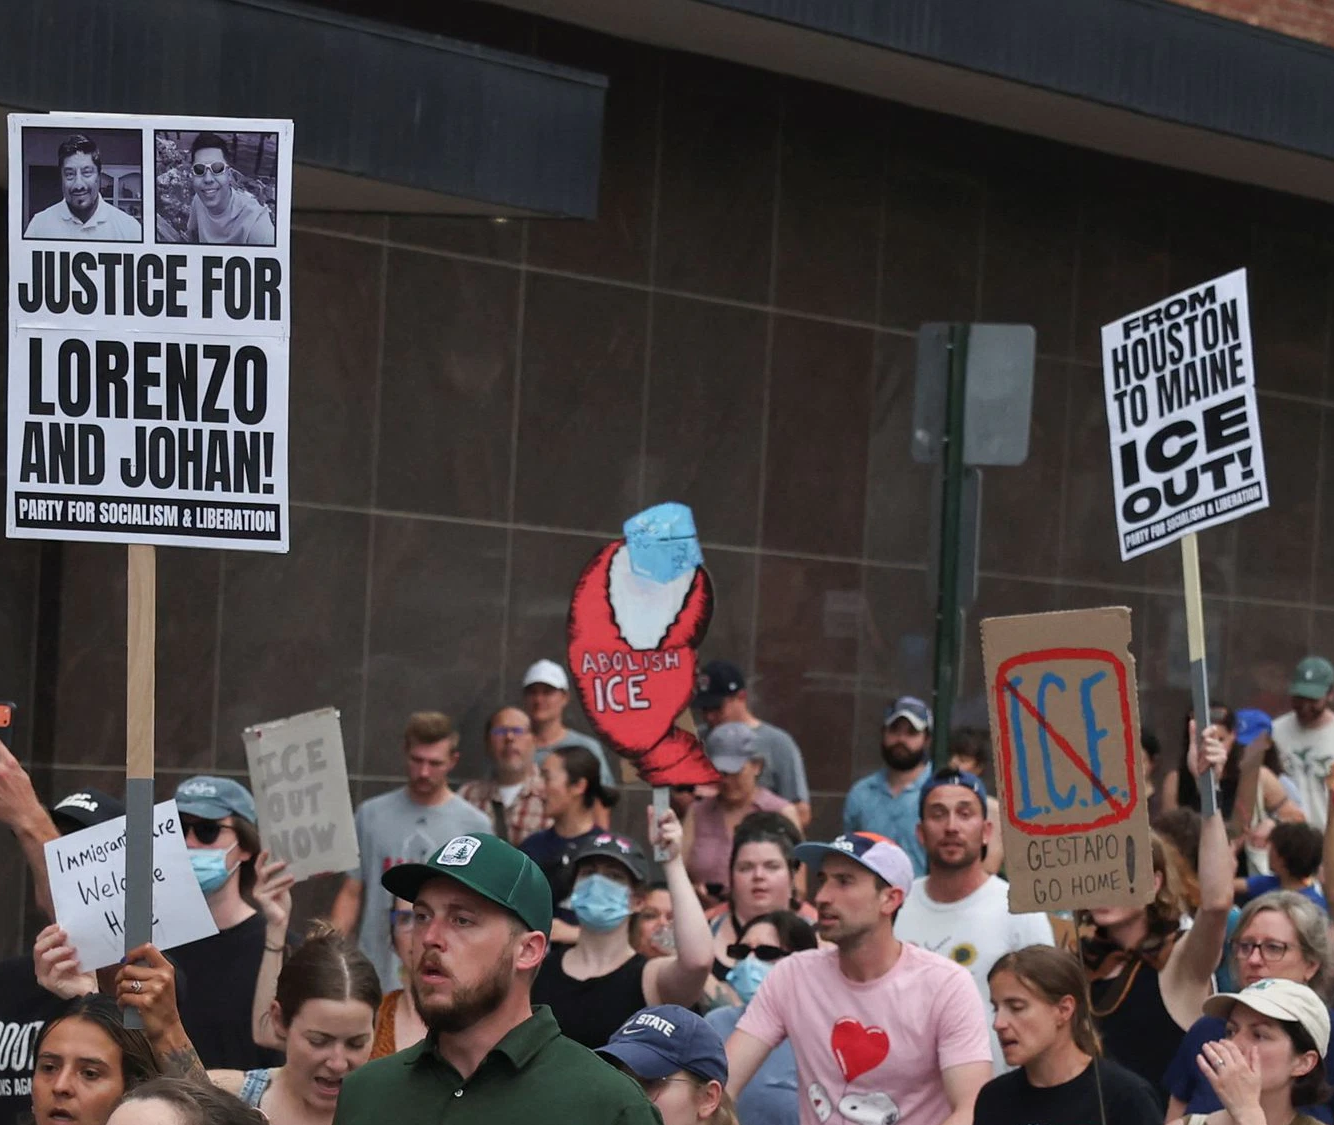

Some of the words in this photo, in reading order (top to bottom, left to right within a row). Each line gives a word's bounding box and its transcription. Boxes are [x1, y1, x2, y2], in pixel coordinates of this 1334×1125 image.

[18, 251, 188, 318] JUSTICE
[202, 256, 281, 321] FOR
[1123, 285, 1216, 340] FROM
[1112, 298, 1240, 391] HOUSTON
[29, 337, 268, 425] LORENZO
[1114, 384, 1148, 434] TO
[1156, 343, 1245, 419] MAINE
[20, 421, 105, 486] AND
[120, 426, 274, 494] JOHAN!
[1120, 396, 1250, 489] ICE
[1122, 446, 1255, 524] OUT!
[1215, 484, 1261, 513] LIBERATION
[19, 499, 63, 520] PARTY
[68, 501, 95, 522] FOR
[99, 503, 178, 527] SOCIALISM
[183, 509, 192, 527] &
[196, 507, 276, 532] LIBERATION
[582, 652, 680, 674] ABOLISH
[594, 675, 651, 712] ICE
[257, 738, 327, 791] ICE
[268, 782, 323, 823] OUT
[153, 818, 176, 838] re
[268, 822, 336, 864] NOW
[1027, 834, 1118, 871] GESTAPO
[1033, 878, 1062, 904] GO
[1071, 870, 1121, 896] HOME
[636, 1013, 676, 1037] STATE
